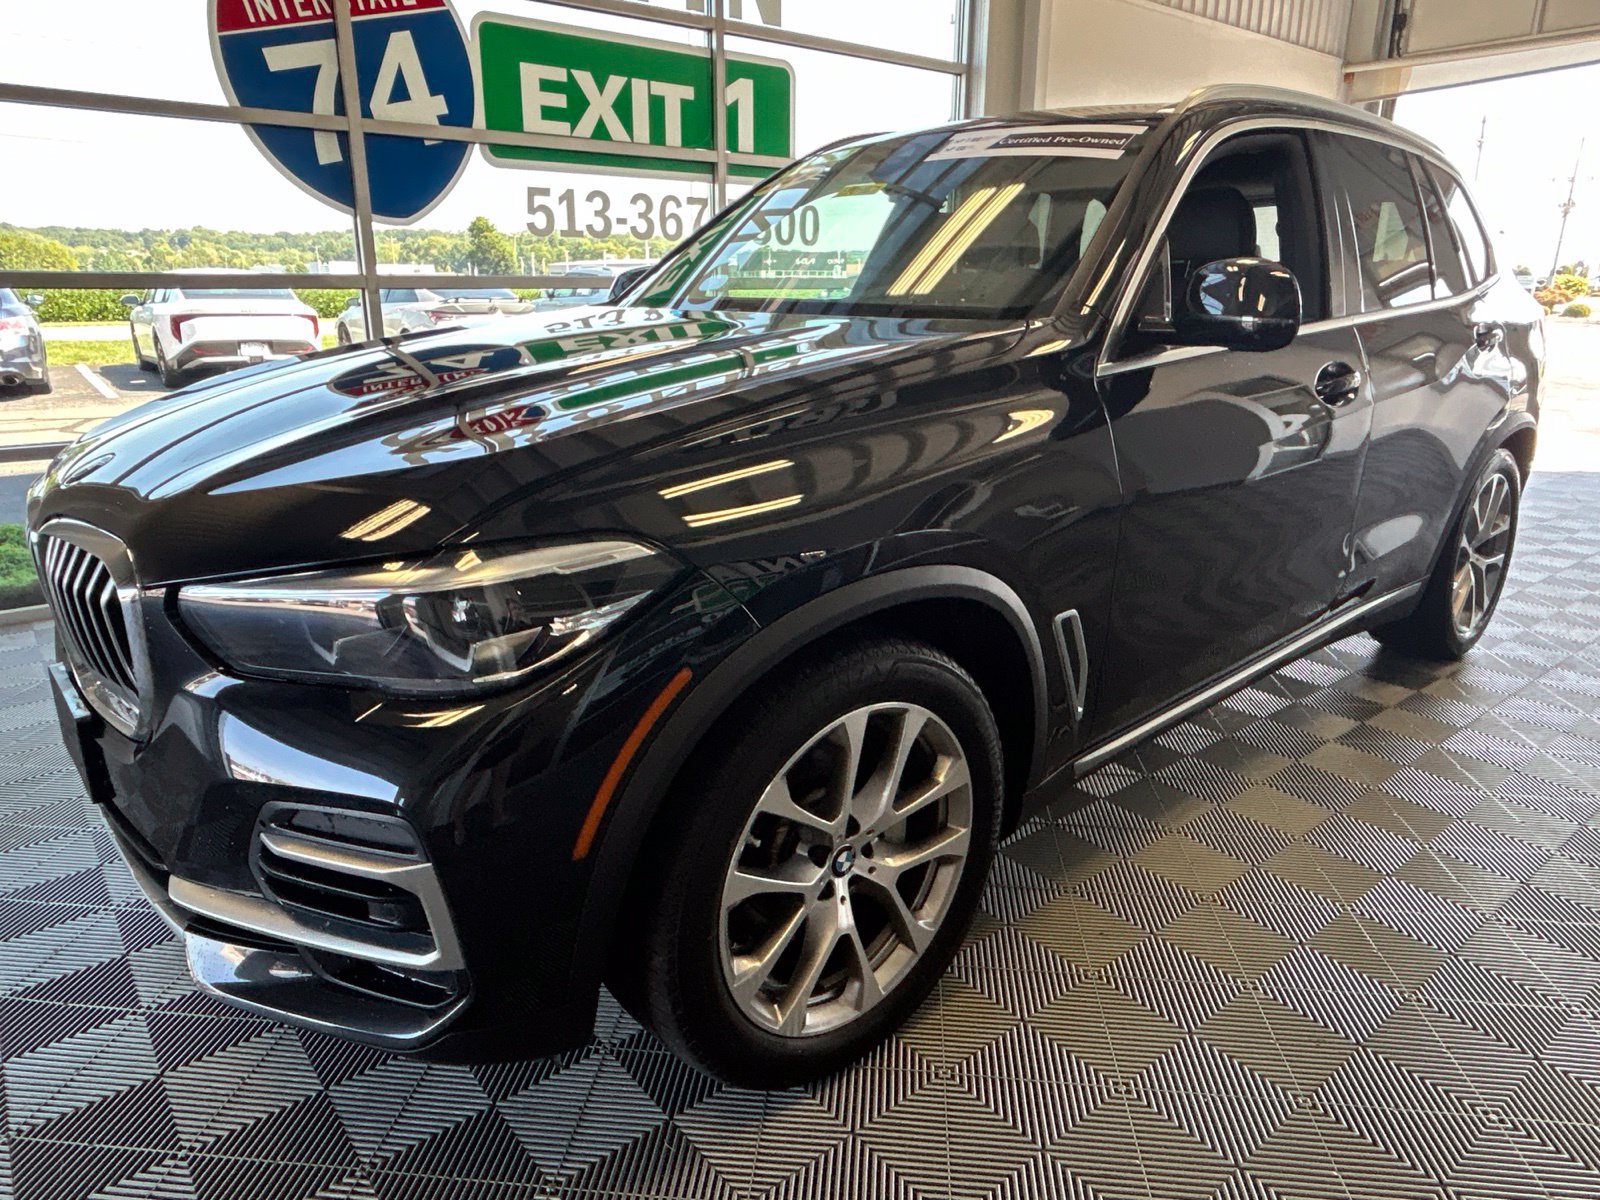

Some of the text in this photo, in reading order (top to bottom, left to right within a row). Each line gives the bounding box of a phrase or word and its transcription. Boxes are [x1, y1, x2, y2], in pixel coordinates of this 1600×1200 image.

[262, 30, 449, 165] 74
[519, 61, 754, 153] EXIT 1
[999, 136, 1052, 145] Certified
[1052, 136, 1127, 145] Pre-Owned
